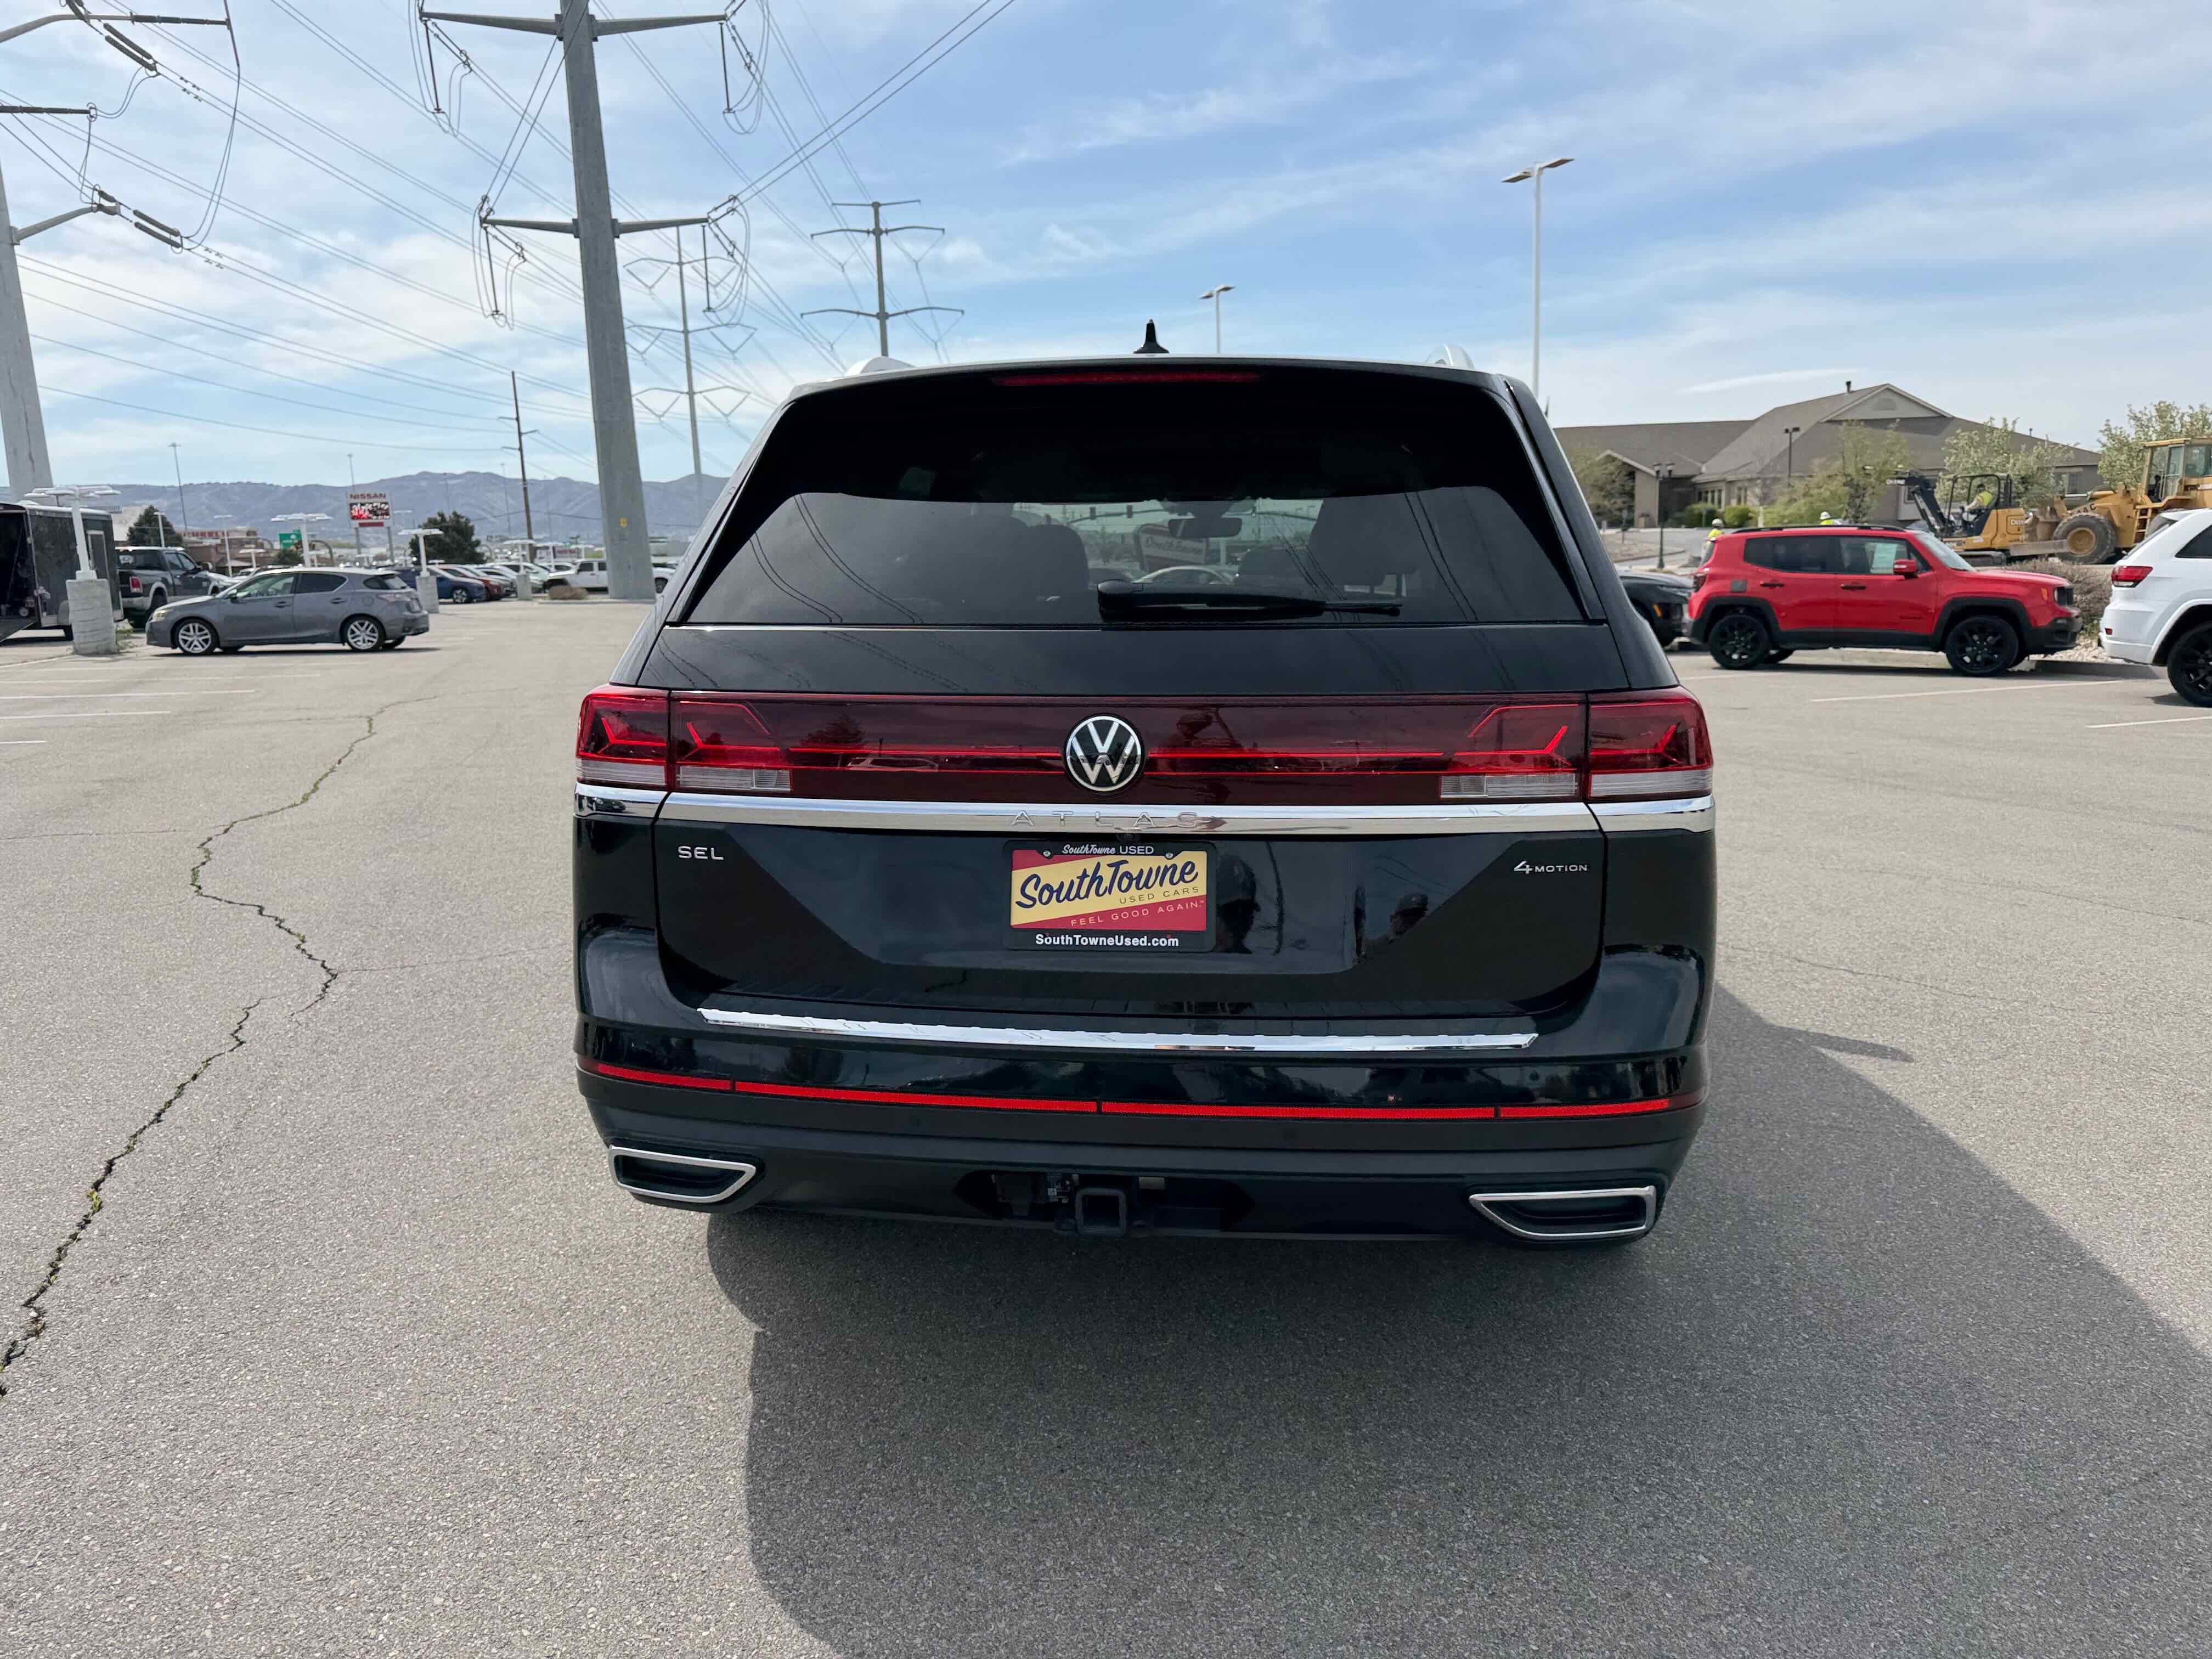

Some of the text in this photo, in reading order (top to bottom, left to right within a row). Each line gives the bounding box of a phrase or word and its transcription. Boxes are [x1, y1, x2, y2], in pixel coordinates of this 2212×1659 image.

[1011, 810, 1198, 828] ATLAS
[678, 845, 724, 861] SEL
[1062, 843, 1154, 855] SouthTowne USED
[1015, 860, 1199, 909] SouthTowne
[1119, 886, 1199, 905] USED CARS
[1071, 916, 1103, 927] FEEL
[1111, 908, 1149, 921] GOOD
[1035, 934, 1180, 947] SouthTowneUsed.com
